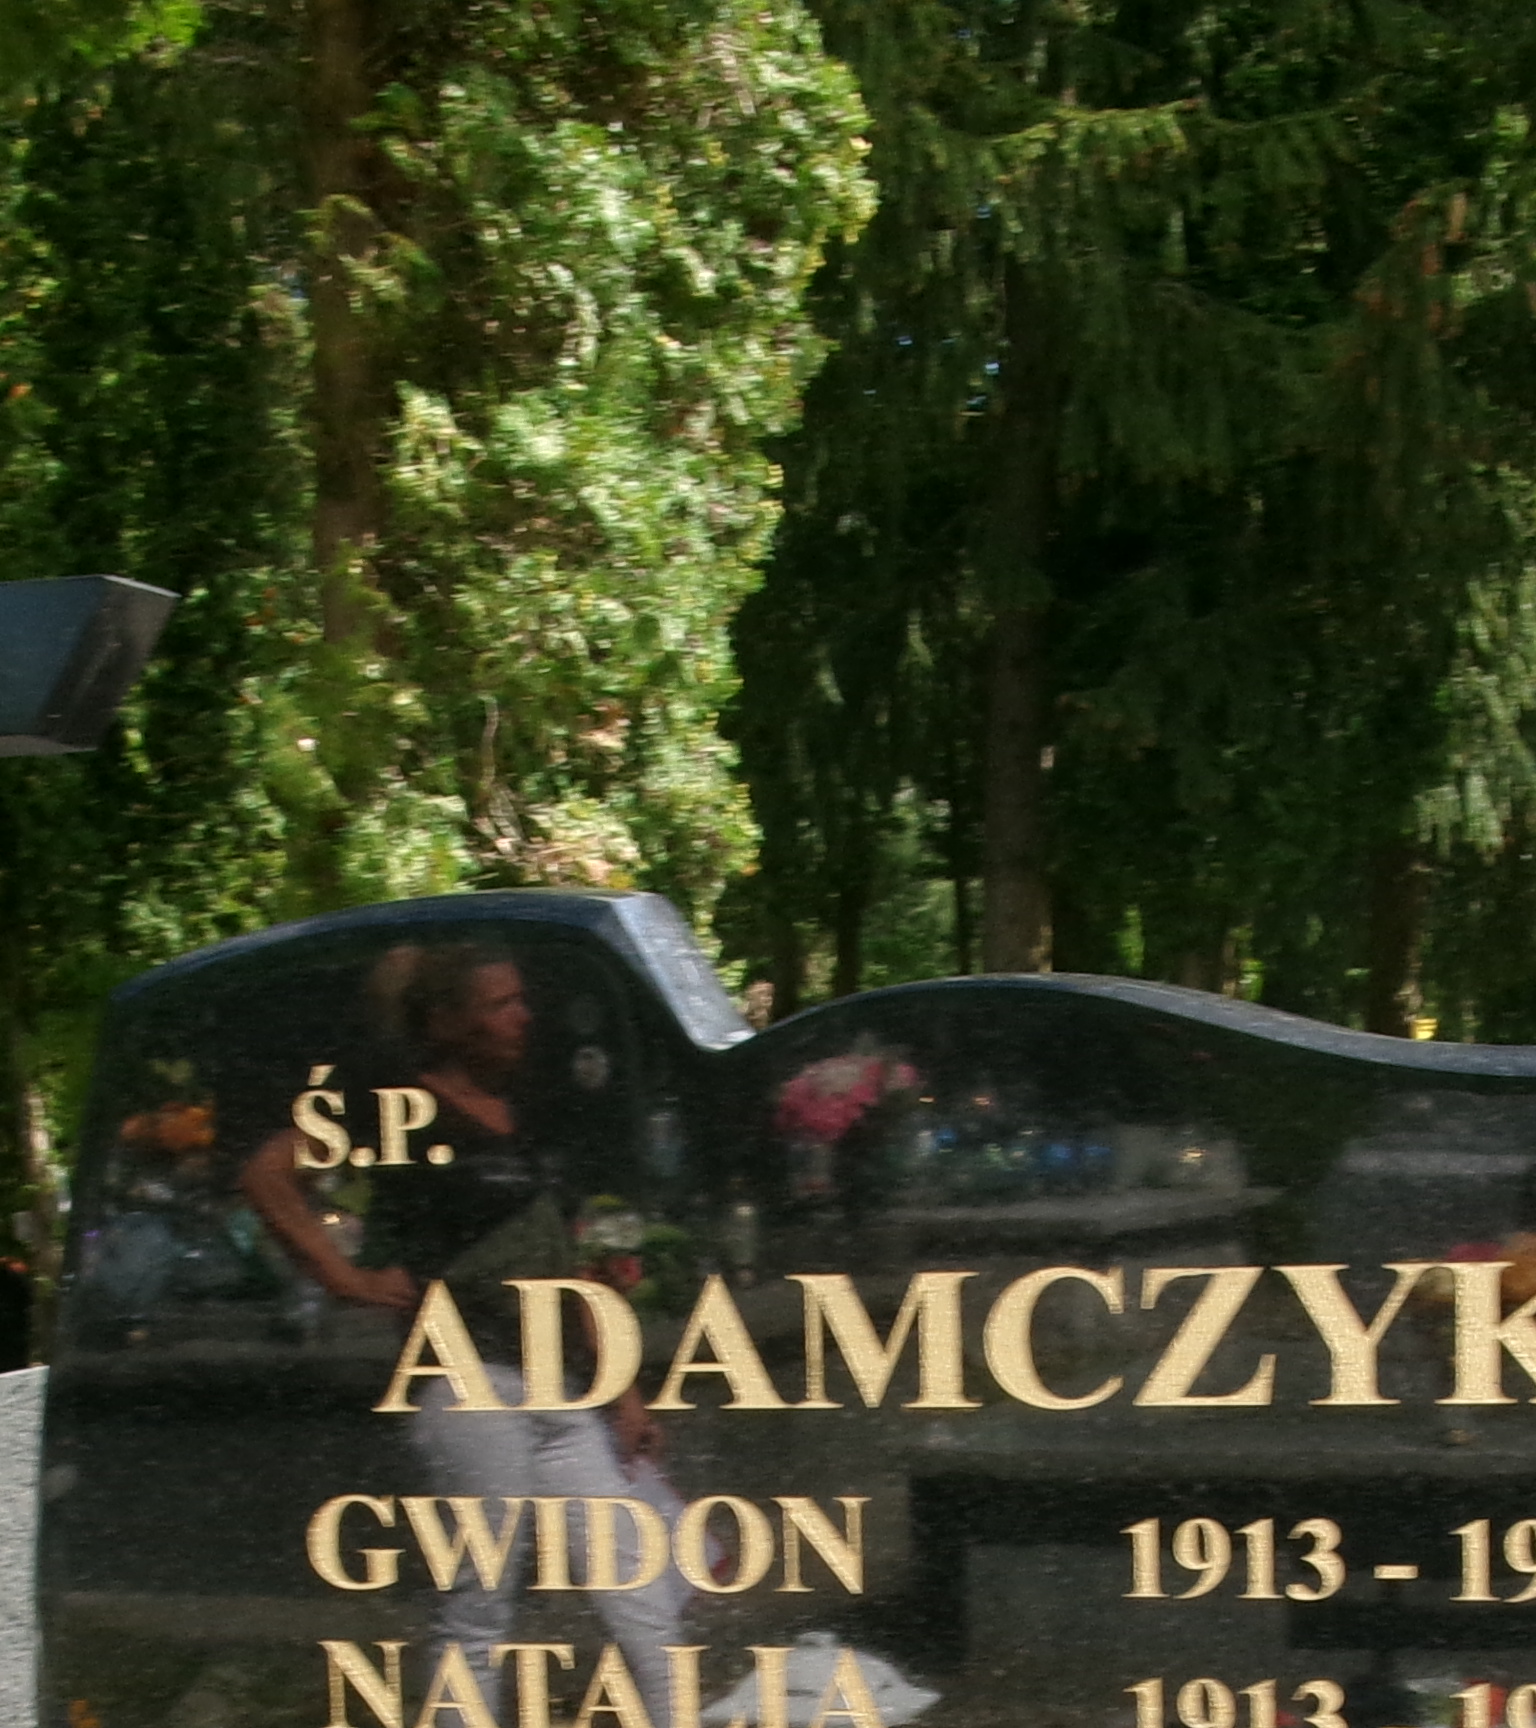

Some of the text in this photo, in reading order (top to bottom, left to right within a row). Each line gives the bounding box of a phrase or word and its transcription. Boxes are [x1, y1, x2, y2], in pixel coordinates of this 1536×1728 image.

[291, 1063, 455, 1169] Ś.P.
[304, 1493, 867, 1596] GWIDON
[1121, 1516, 1346, 1603] 1913
